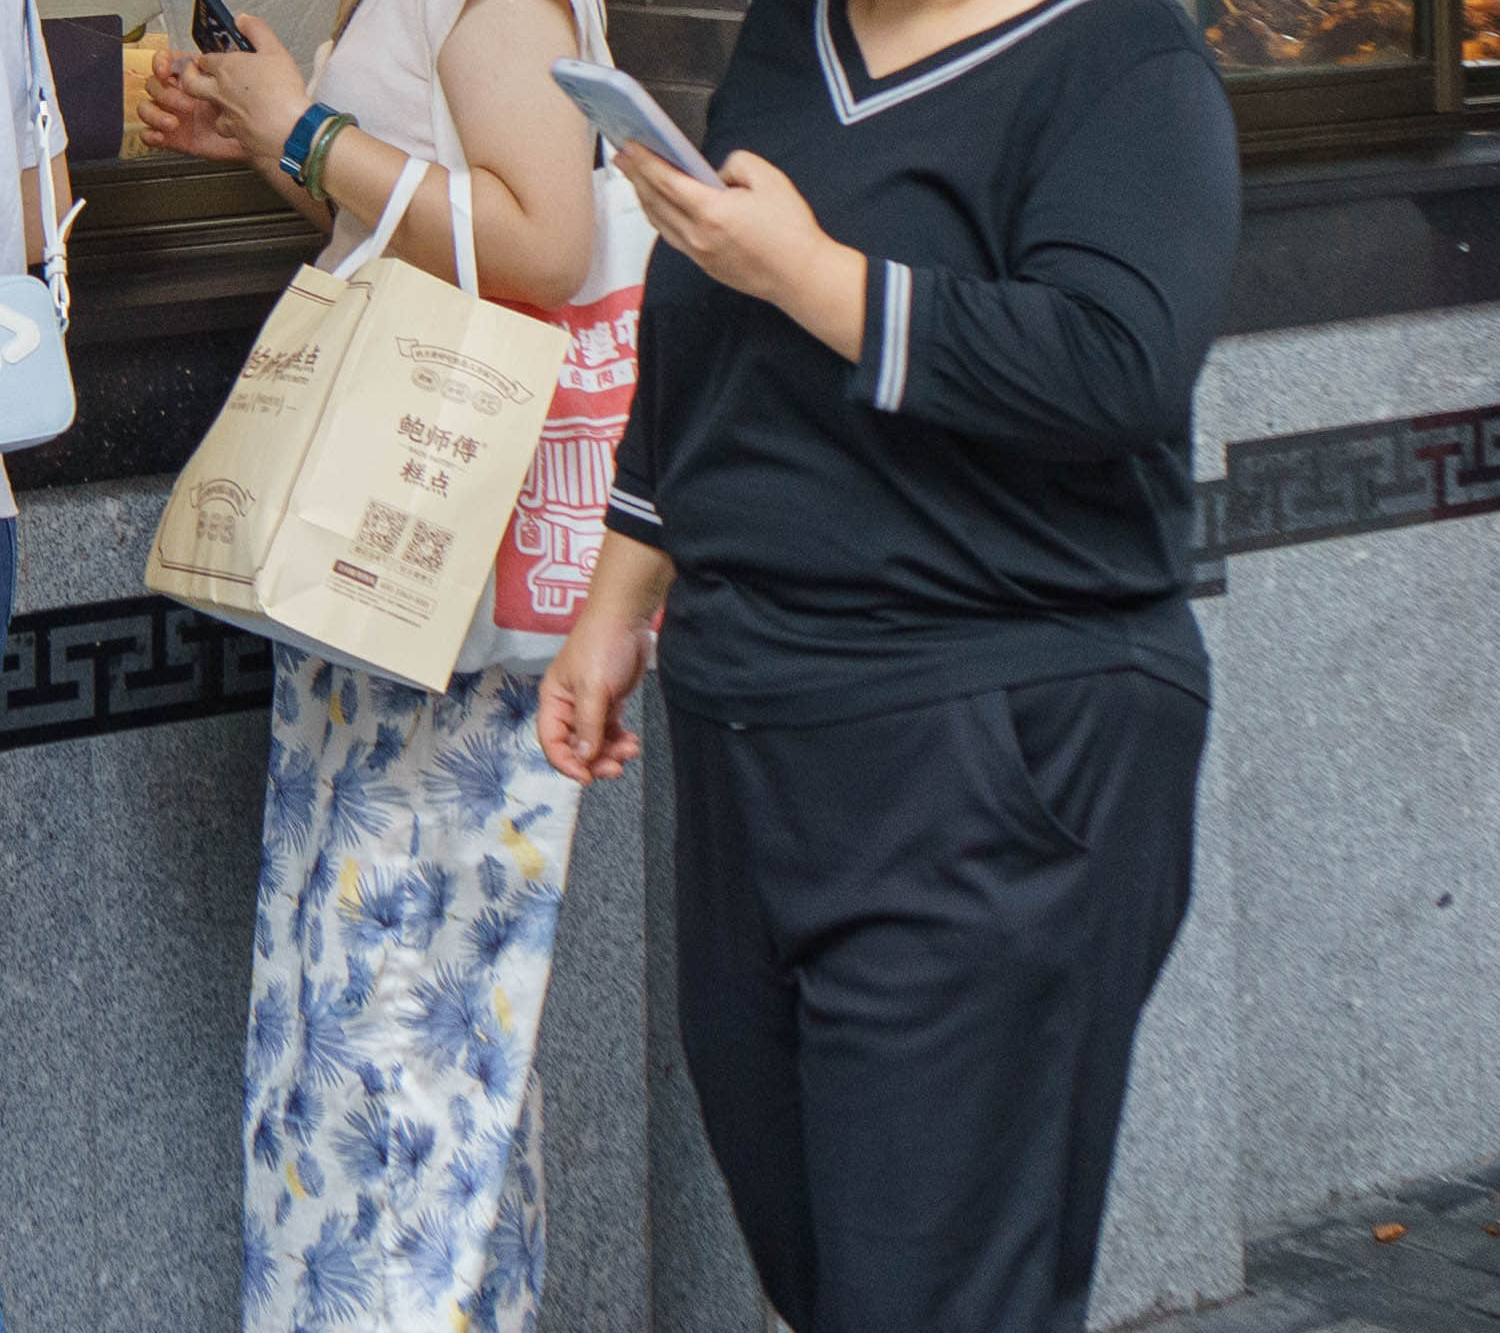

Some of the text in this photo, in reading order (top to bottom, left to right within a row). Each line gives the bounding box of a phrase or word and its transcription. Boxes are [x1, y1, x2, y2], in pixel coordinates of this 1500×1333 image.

[397, 413, 481, 464] 鲍师傅
[399, 457, 451, 499] 糕点
